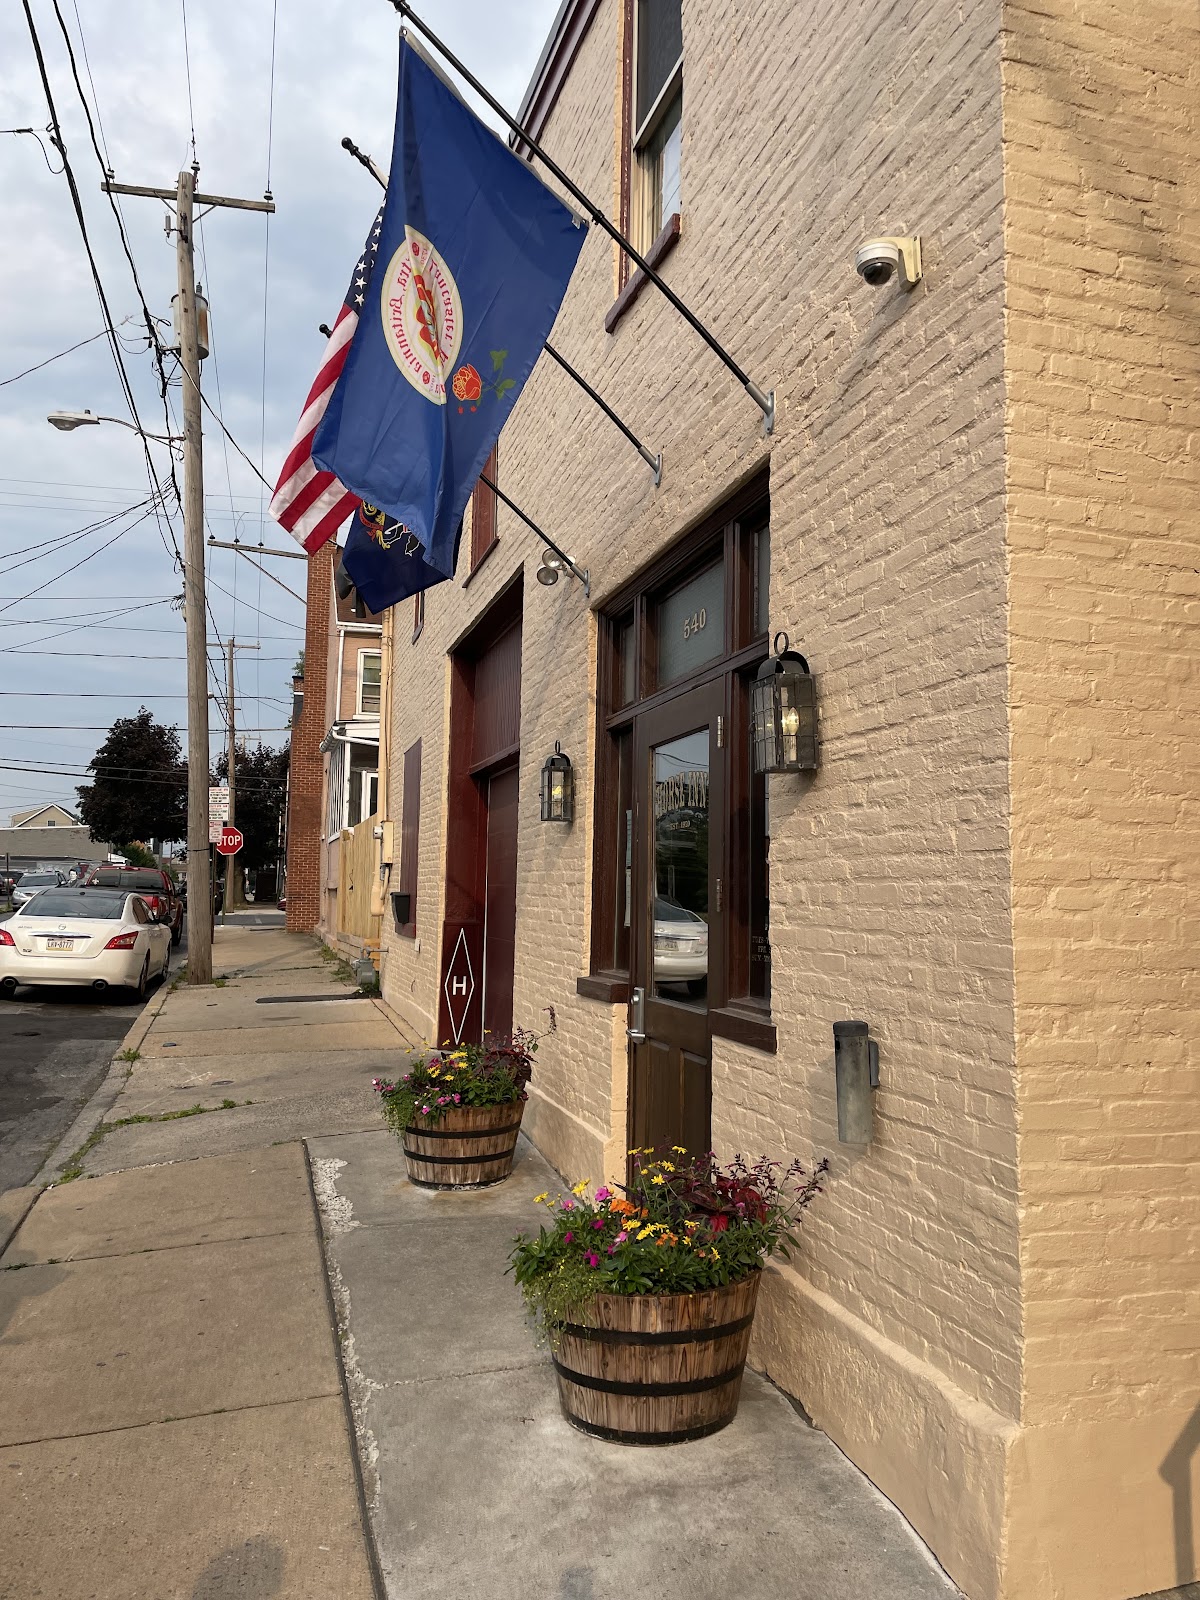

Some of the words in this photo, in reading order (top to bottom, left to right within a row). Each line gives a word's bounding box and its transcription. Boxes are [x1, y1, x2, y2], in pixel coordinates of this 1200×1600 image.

[683, 607, 706, 639] 540
[656, 771, 685, 819] HORSE
[688, 770, 709, 808] INN
[452, 975, 467, 996] H
